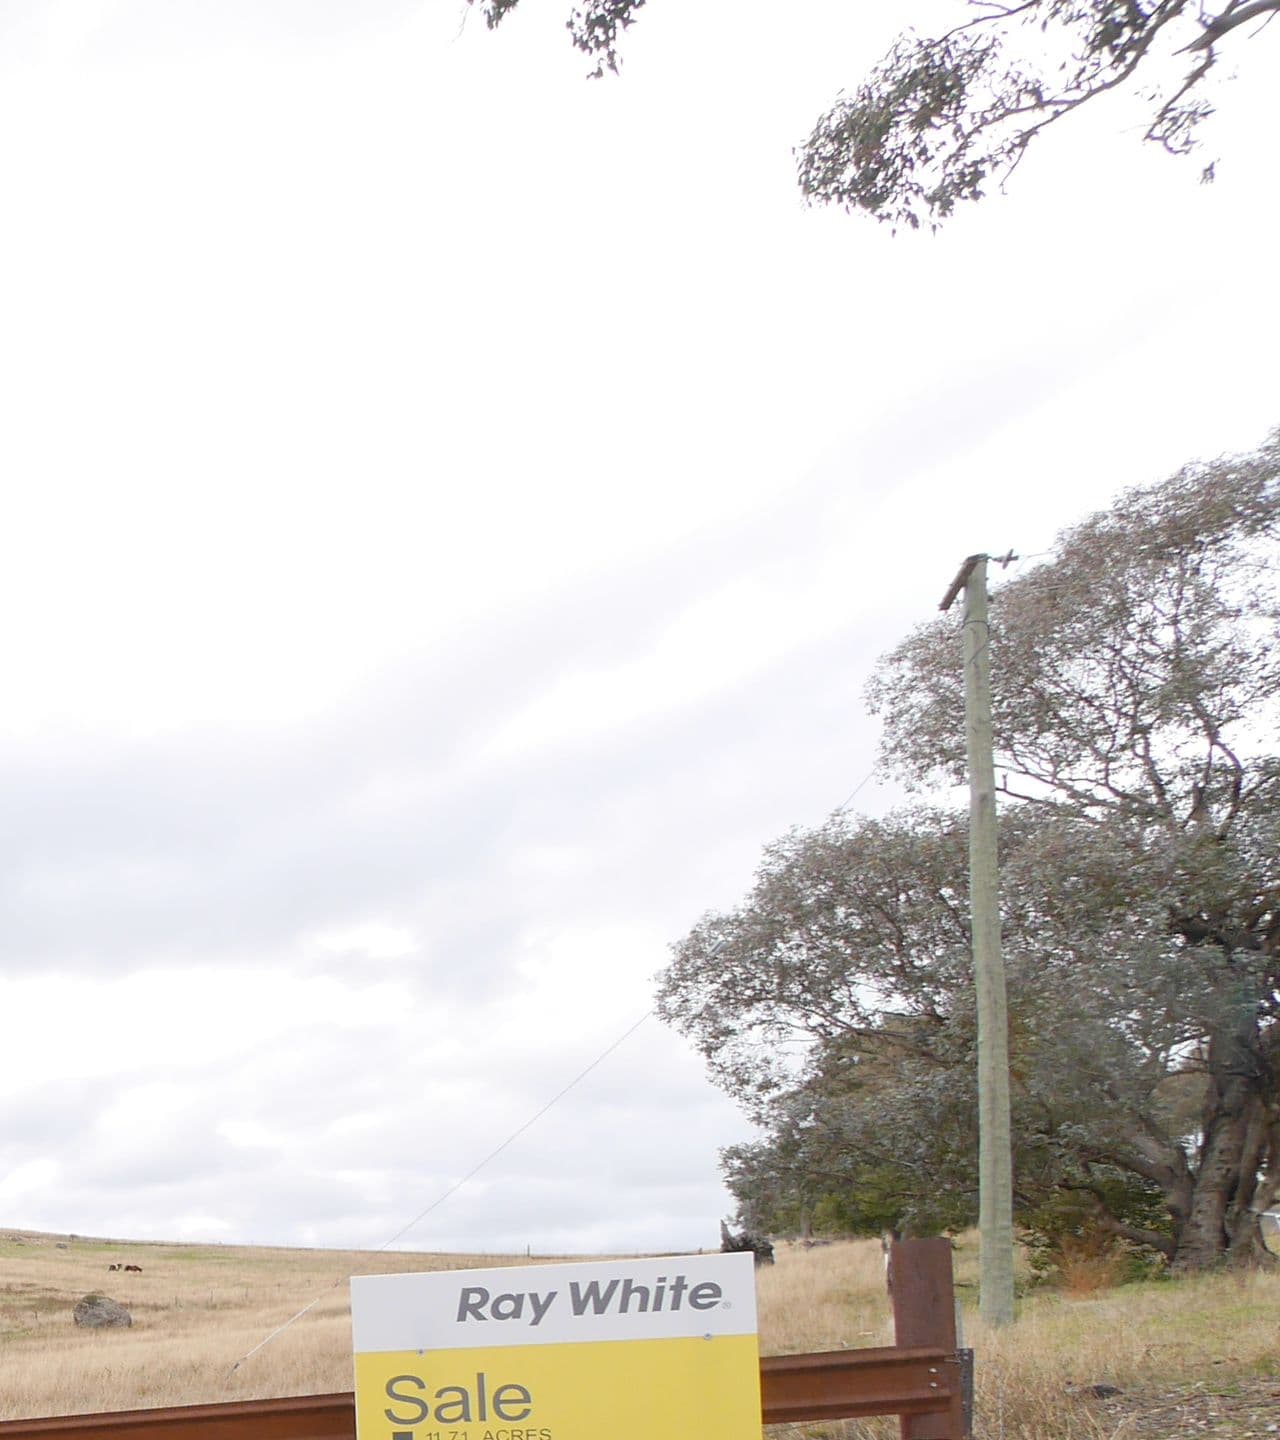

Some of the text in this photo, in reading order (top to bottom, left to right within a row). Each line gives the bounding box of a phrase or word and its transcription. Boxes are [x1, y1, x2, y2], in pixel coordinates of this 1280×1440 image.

[456, 1275, 723, 1326] Ray White
[383, 1372, 532, 1426] Sale
